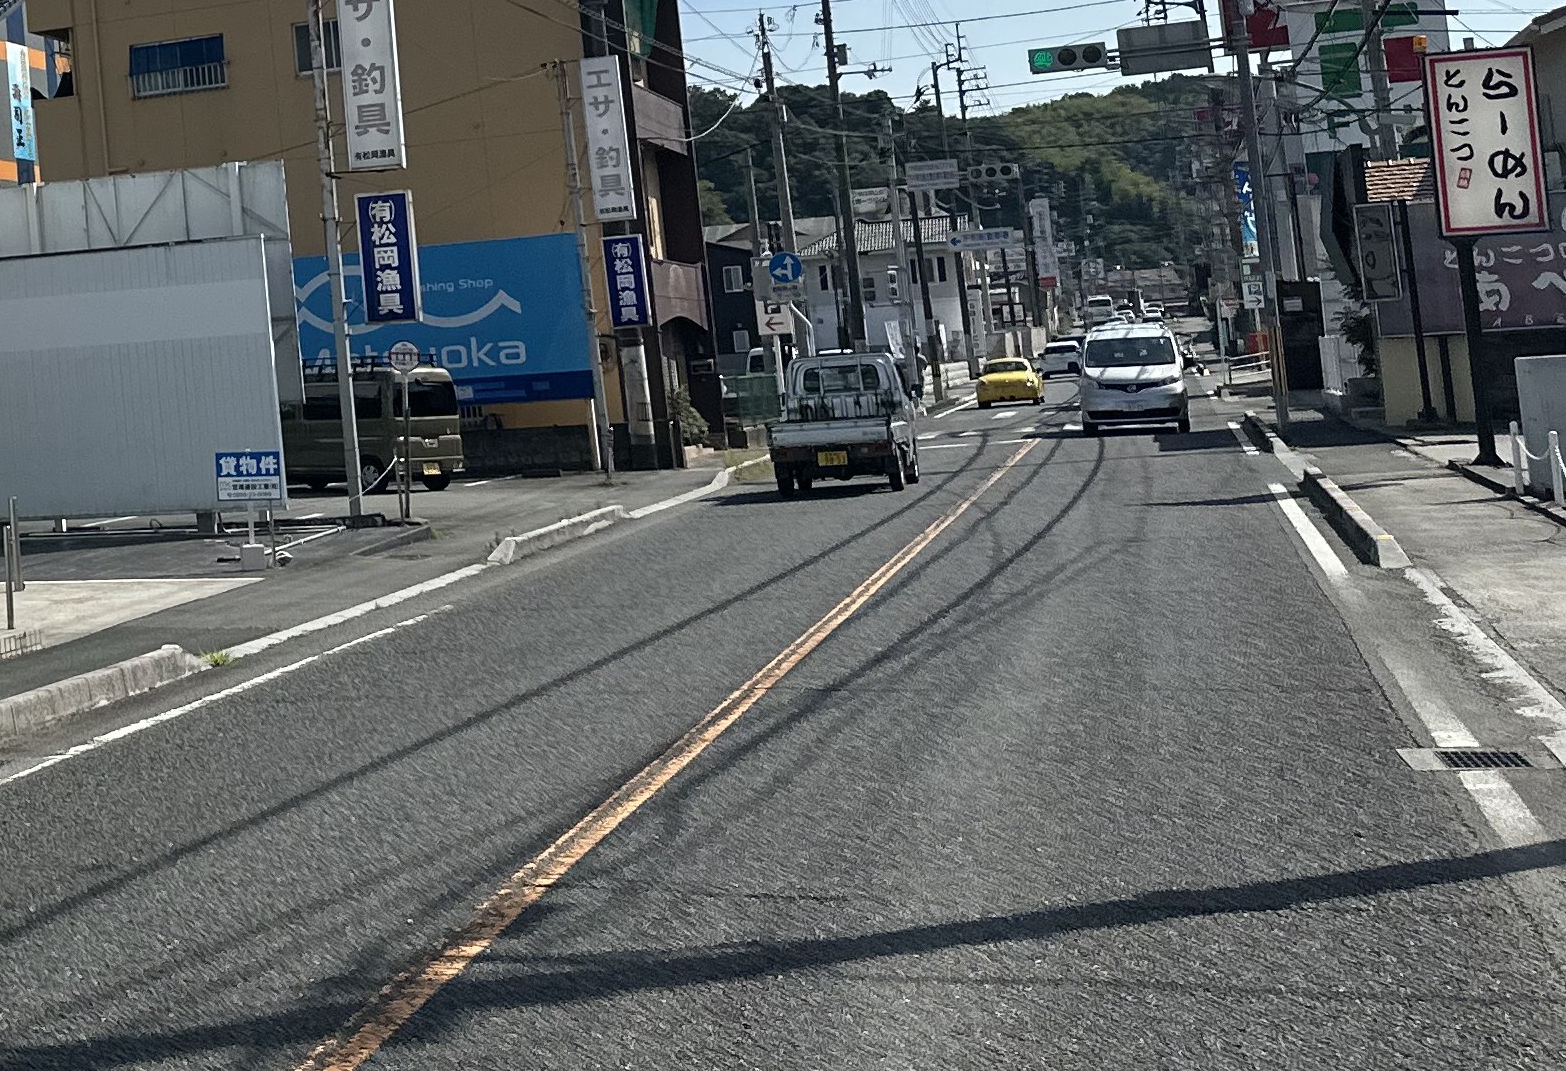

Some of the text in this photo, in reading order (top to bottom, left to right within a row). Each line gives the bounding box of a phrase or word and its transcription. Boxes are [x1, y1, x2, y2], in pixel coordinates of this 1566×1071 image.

[586, 68, 626, 198] エサ・釣具
[1444, 68, 1475, 162] とんこつ
[1481, 66, 1531, 221] らーめん
[458, 278, 494, 290] Shop
[311, 336, 528, 376] Mtoka
[218, 455, 278, 476] 貸物件
